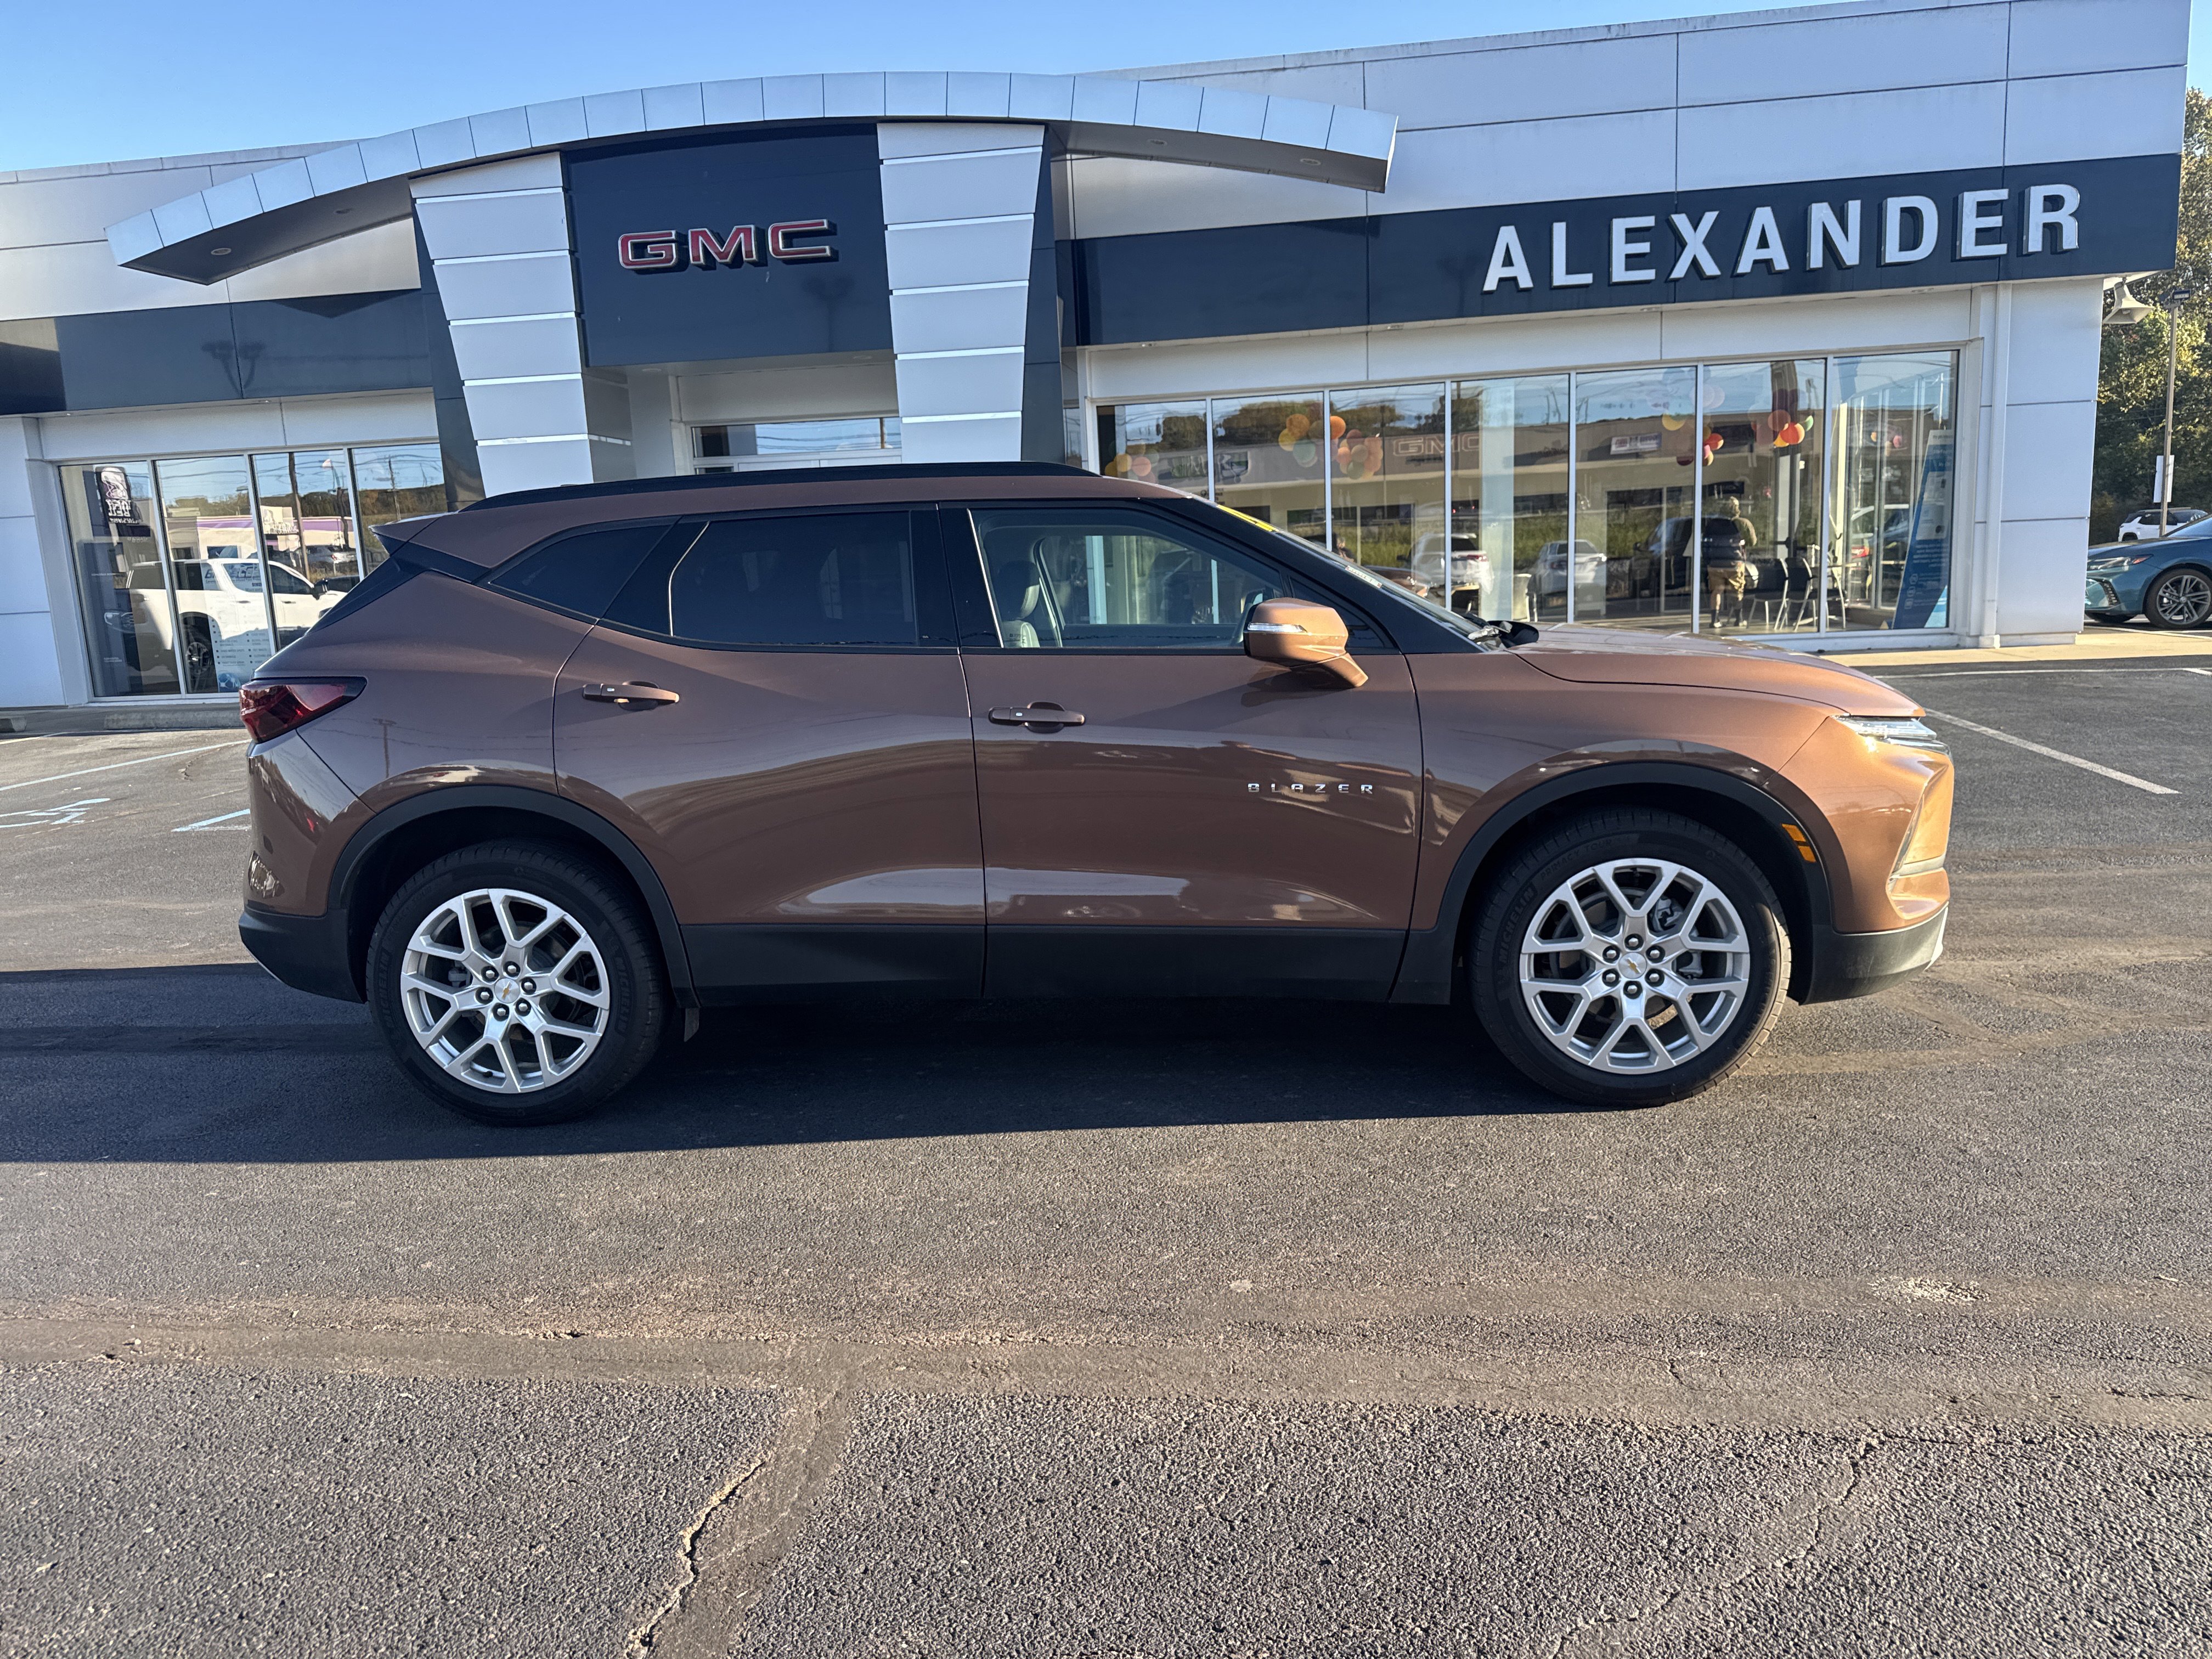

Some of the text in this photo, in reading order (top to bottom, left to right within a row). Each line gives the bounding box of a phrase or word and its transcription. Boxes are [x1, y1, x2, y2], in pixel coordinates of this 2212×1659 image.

[618, 218, 832, 269] GMC
[1482, 183, 2081, 293] ALEXANDER
[1393, 432, 1480, 456] GMC
[1247, 783, 1373, 794] BLAZER
[1498, 887, 1535, 964] MICHELIN
[1584, 839, 1613, 852] TOUR
